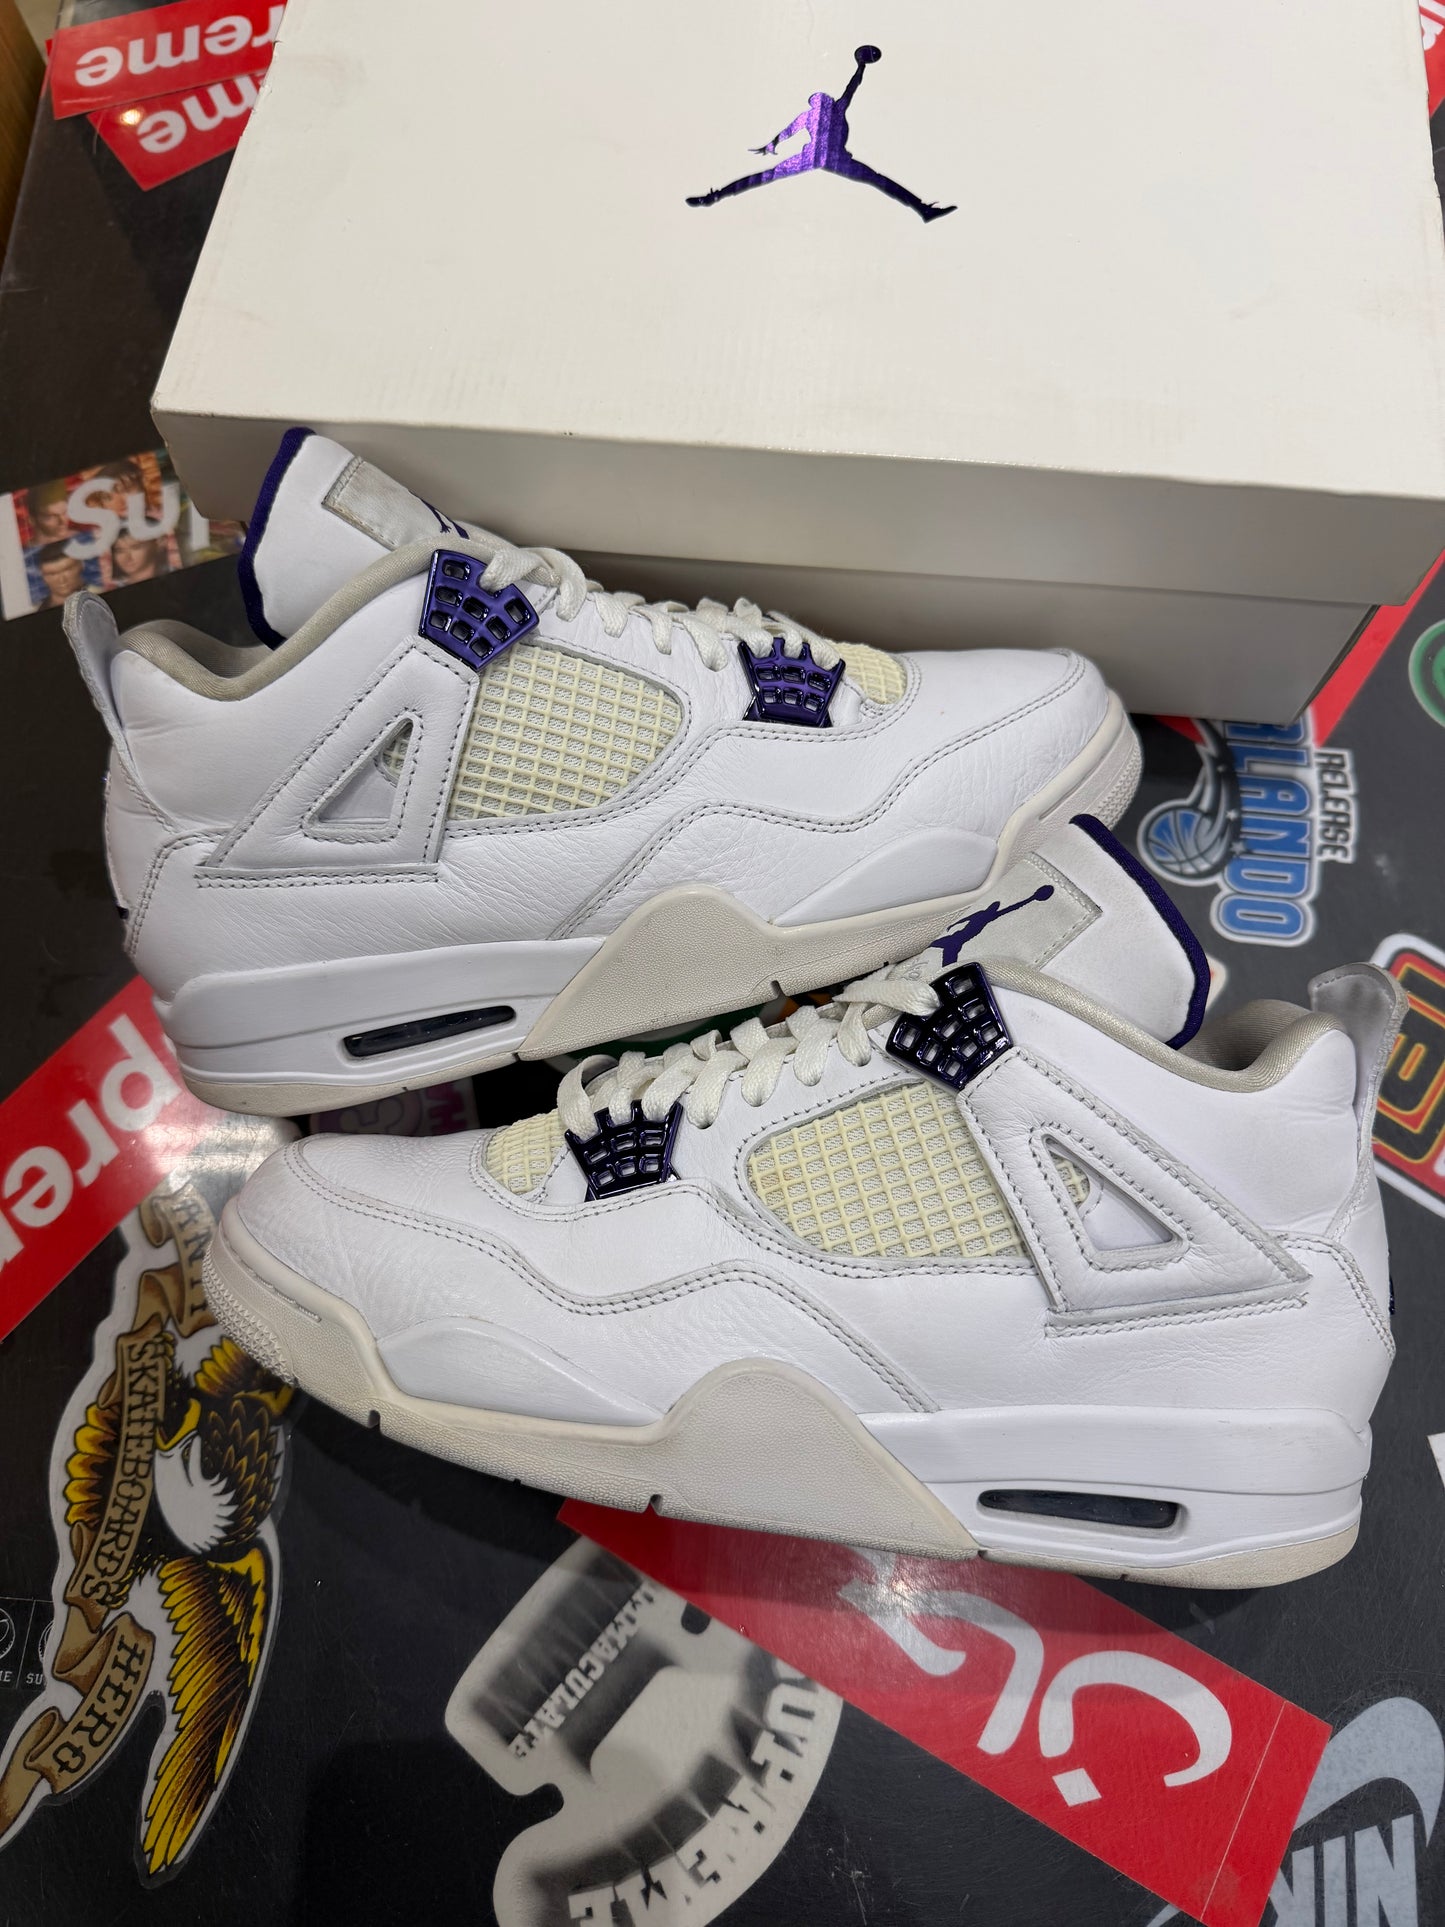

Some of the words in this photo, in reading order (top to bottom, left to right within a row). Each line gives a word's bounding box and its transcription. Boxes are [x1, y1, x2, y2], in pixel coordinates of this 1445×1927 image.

[137, 72, 265, 153] me
[1316, 750, 1350, 860] RELEASE
[82, 1340, 163, 1604] SKATEBOARDS
[52, 1635, 146, 1774] HERO
[507, 1583, 656, 1759] IMMACULATE
[566, 1670, 823, 1927] UPREME
